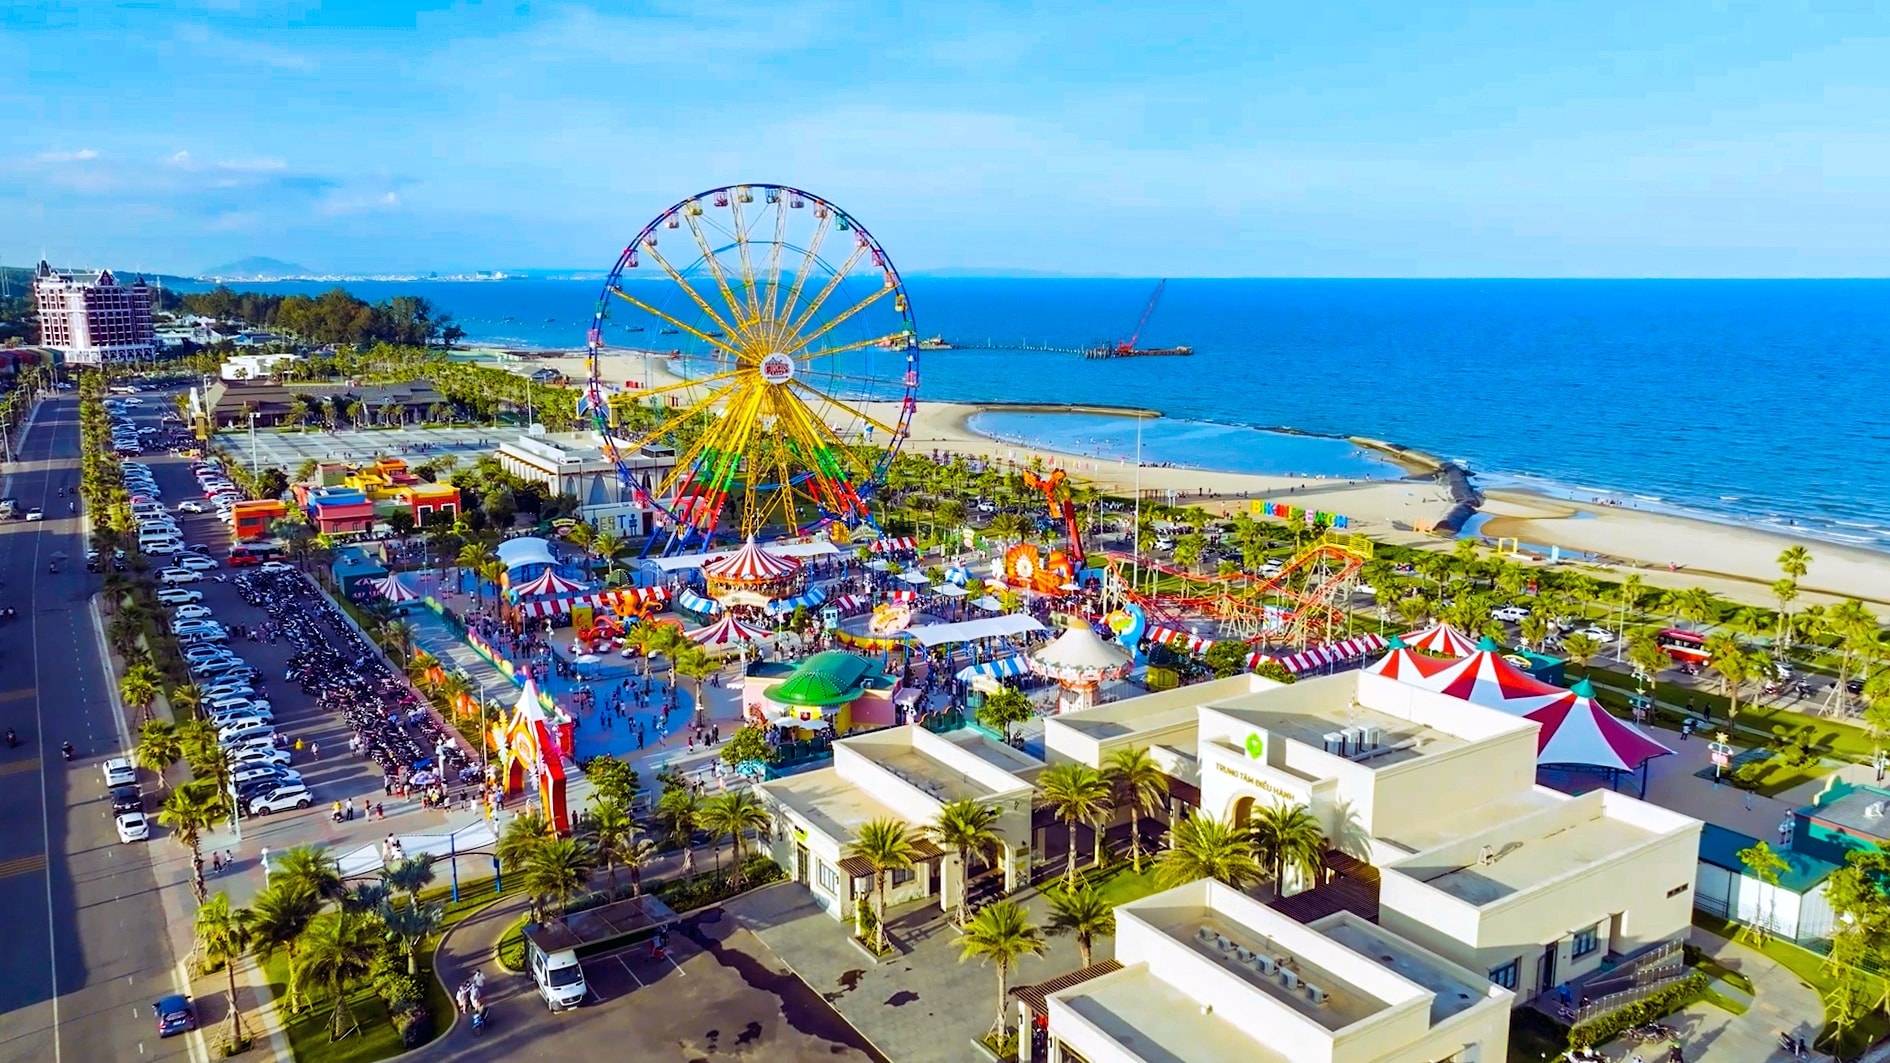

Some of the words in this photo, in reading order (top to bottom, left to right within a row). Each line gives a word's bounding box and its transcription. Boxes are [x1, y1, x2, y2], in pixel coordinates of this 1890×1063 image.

[1251, 499, 1293, 519] BIKINI
[1295, 506, 1348, 529] EACH
[1216, 762, 1239, 778] TRUNG
[1240, 772, 1254, 785] TÂM
[1273, 787, 1295, 801] HÀNH
